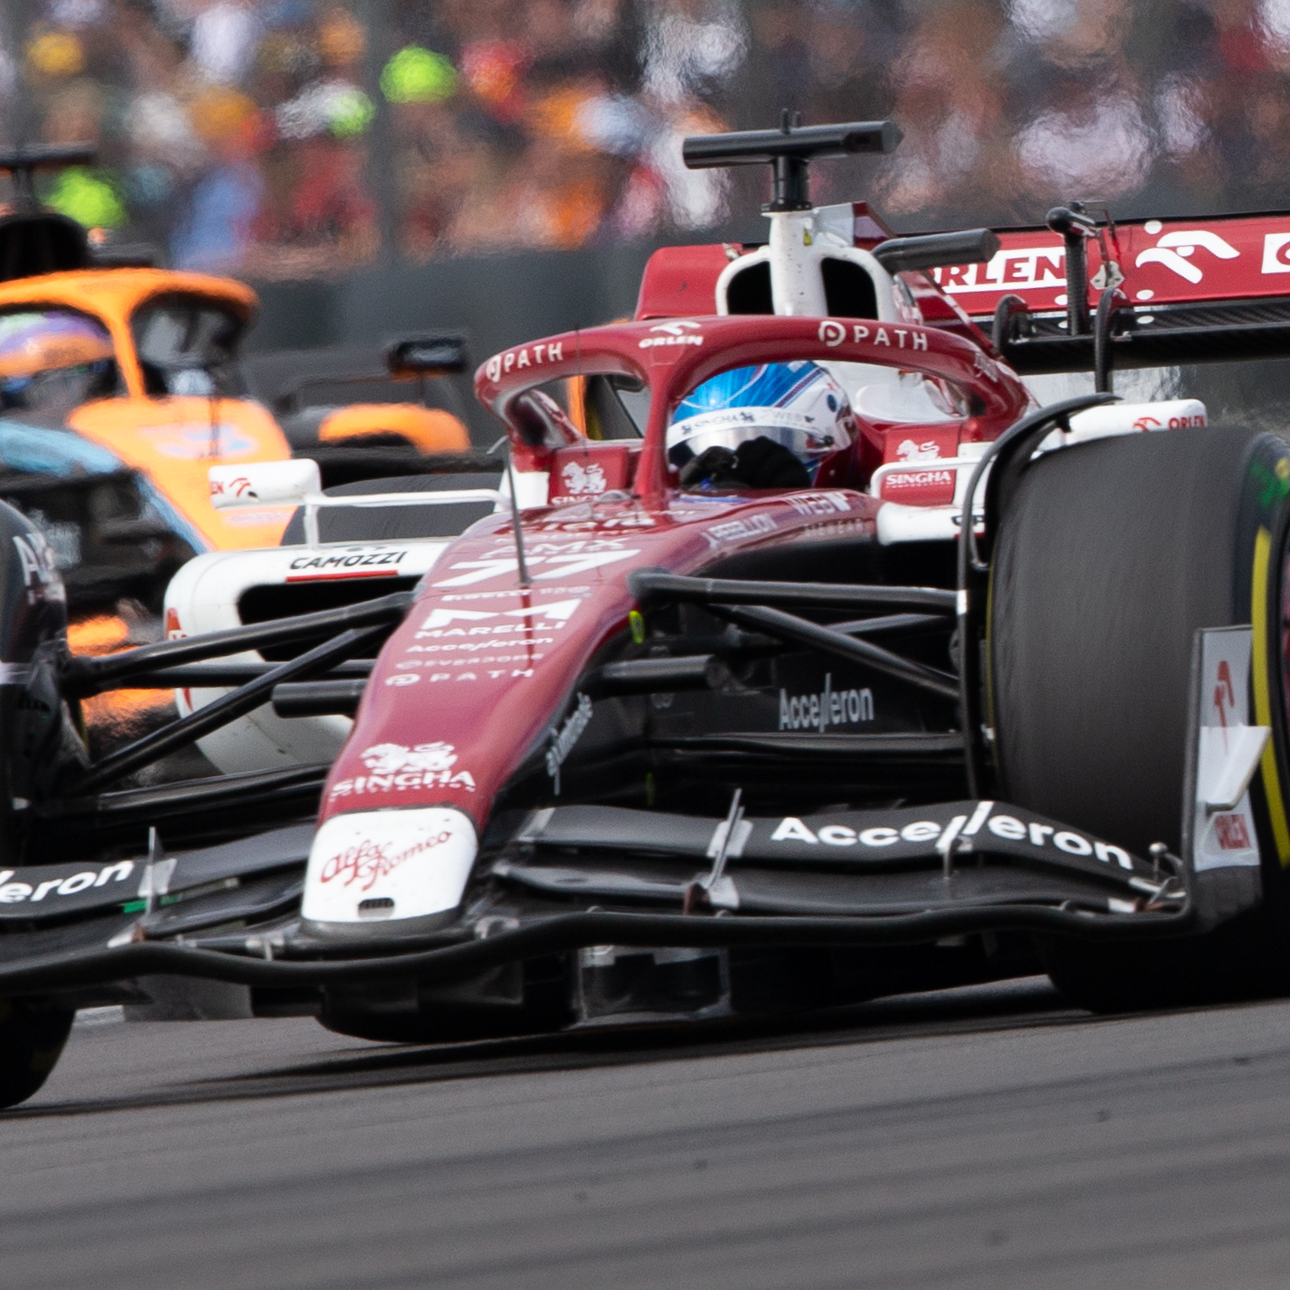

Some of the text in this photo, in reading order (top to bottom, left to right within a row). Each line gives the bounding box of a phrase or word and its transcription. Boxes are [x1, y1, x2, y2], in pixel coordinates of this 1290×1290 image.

[928, 254, 1067, 287] RLEN
[638, 334, 704, 348] ORLEN
[852, 324, 929, 352] PATH
[503, 342, 564, 373] PATH
[885, 471, 952, 485] SINGHA
[289, 551, 408, 570] CAMOZZI
[431, 549, 642, 588] 77
[414, 621, 566, 639] MARELLI
[406, 636, 554, 653] Accelleron
[428, 668, 535, 683] PATH
[778, 672, 875, 733] Accelleron
[332, 770, 476, 793] SINGHA
[770, 800, 1134, 871] Accelleron
[320, 831, 453, 892] Alfa Romeo
